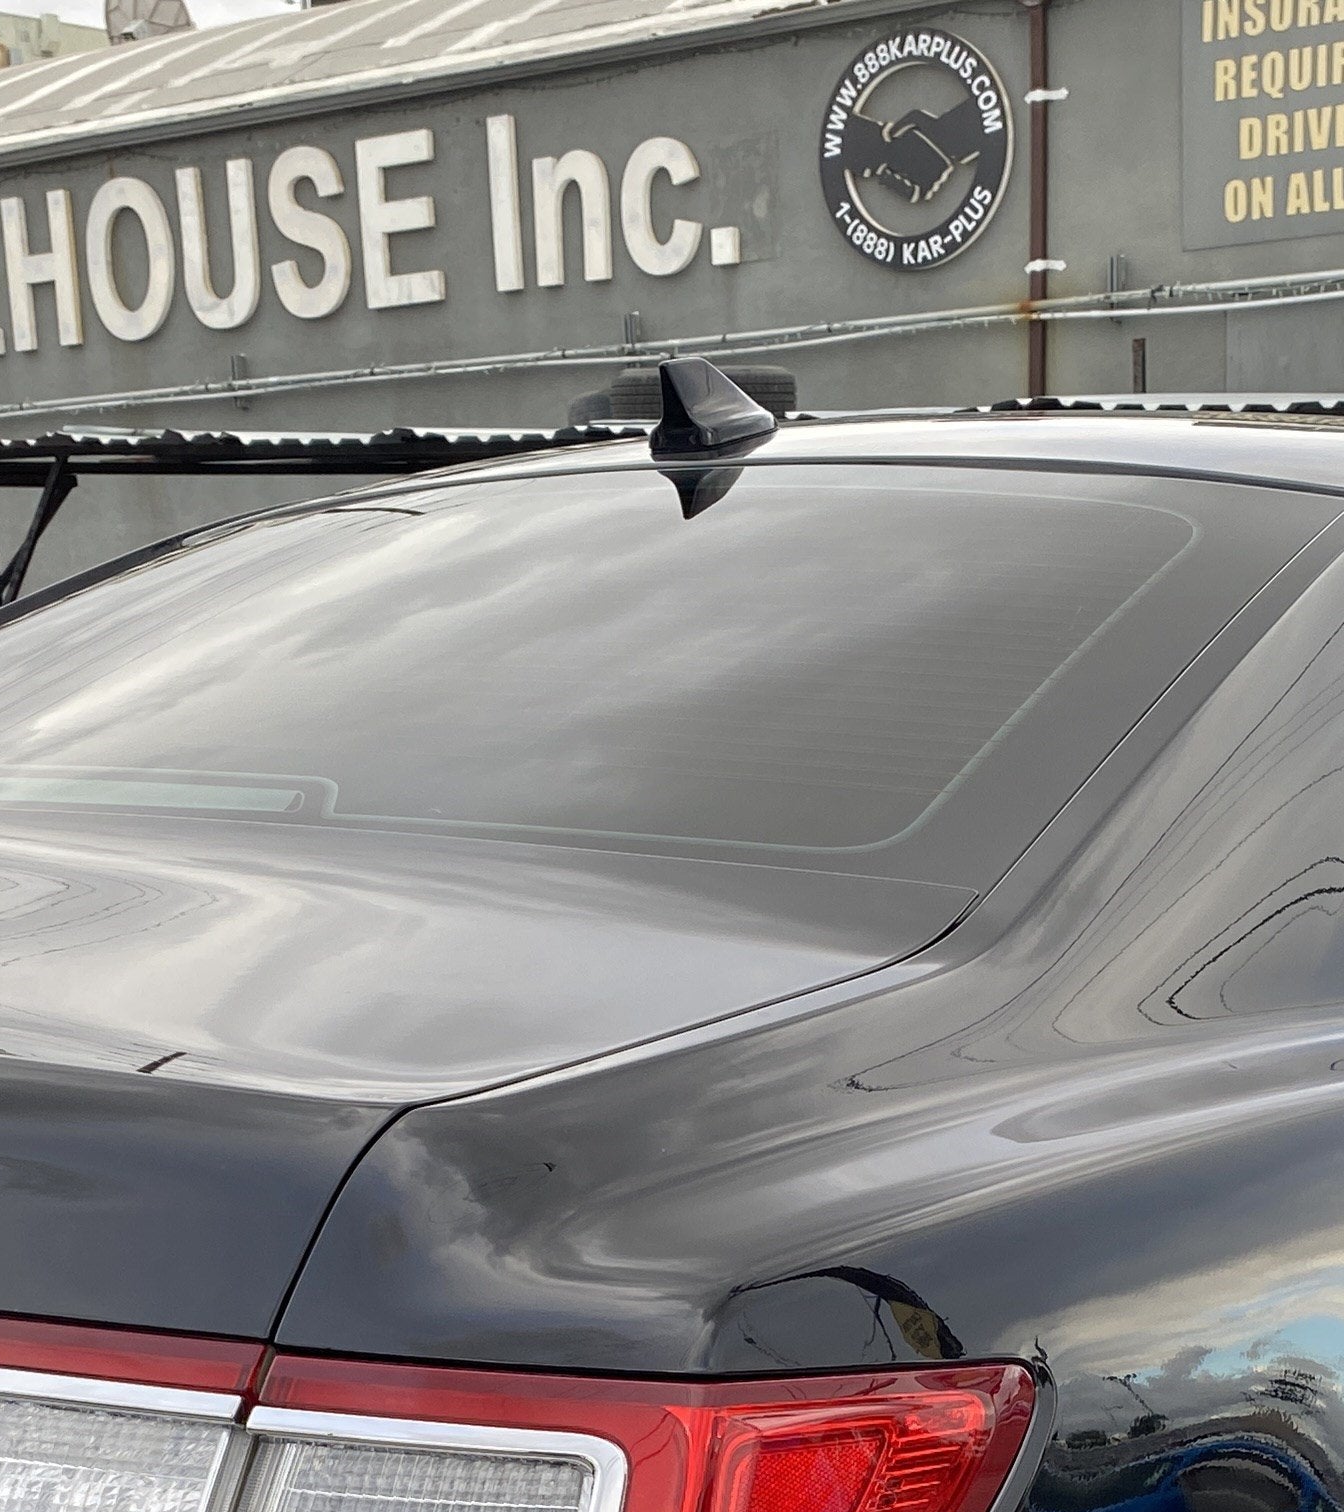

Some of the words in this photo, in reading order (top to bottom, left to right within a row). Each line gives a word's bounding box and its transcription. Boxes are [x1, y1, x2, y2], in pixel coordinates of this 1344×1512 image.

[485, 114, 742, 293] Inc.
[902, 186, 993, 265] KAR-PLUS
[1223, 176, 1275, 224] ON
